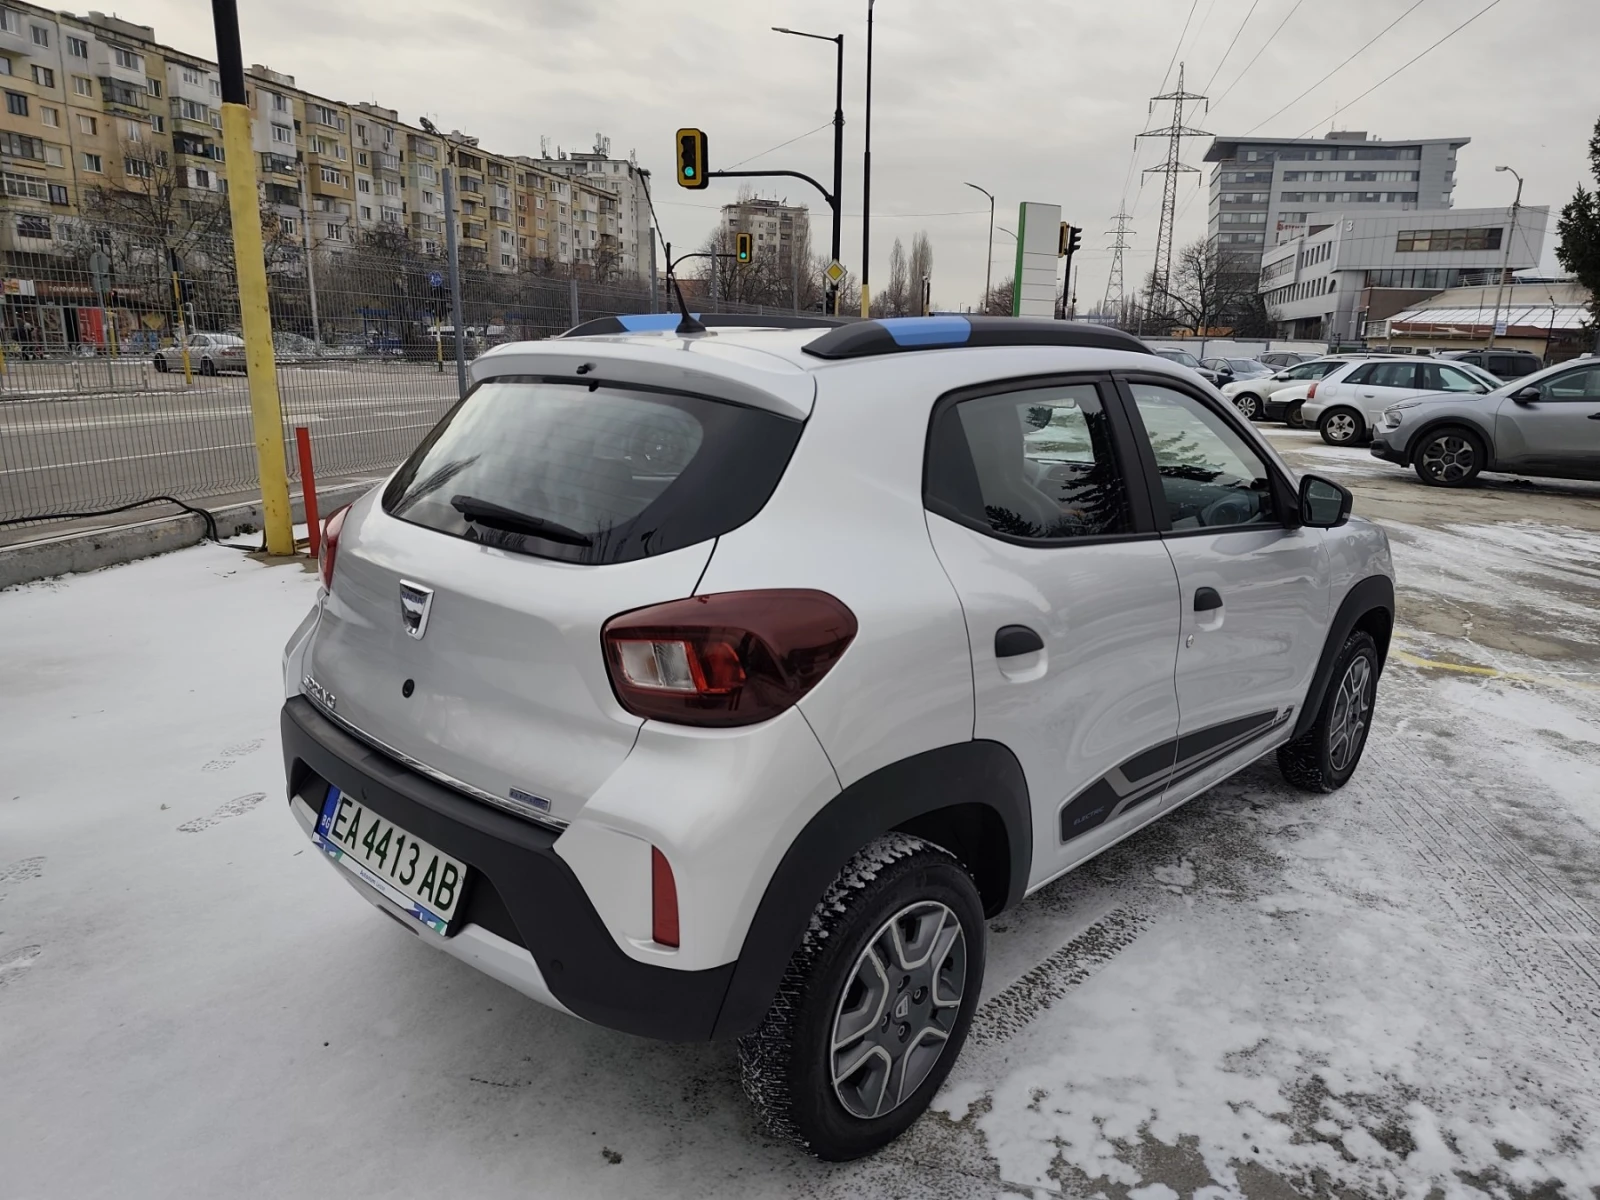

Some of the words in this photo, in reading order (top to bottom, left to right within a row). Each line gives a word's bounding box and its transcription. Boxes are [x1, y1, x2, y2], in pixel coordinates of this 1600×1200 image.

[1345, 220, 1354, 232] 3
[321, 814, 331, 829] BG
[331, 796, 362, 851] EA
[362, 819, 421, 886] 4413
[416, 855, 459, 912] AB
